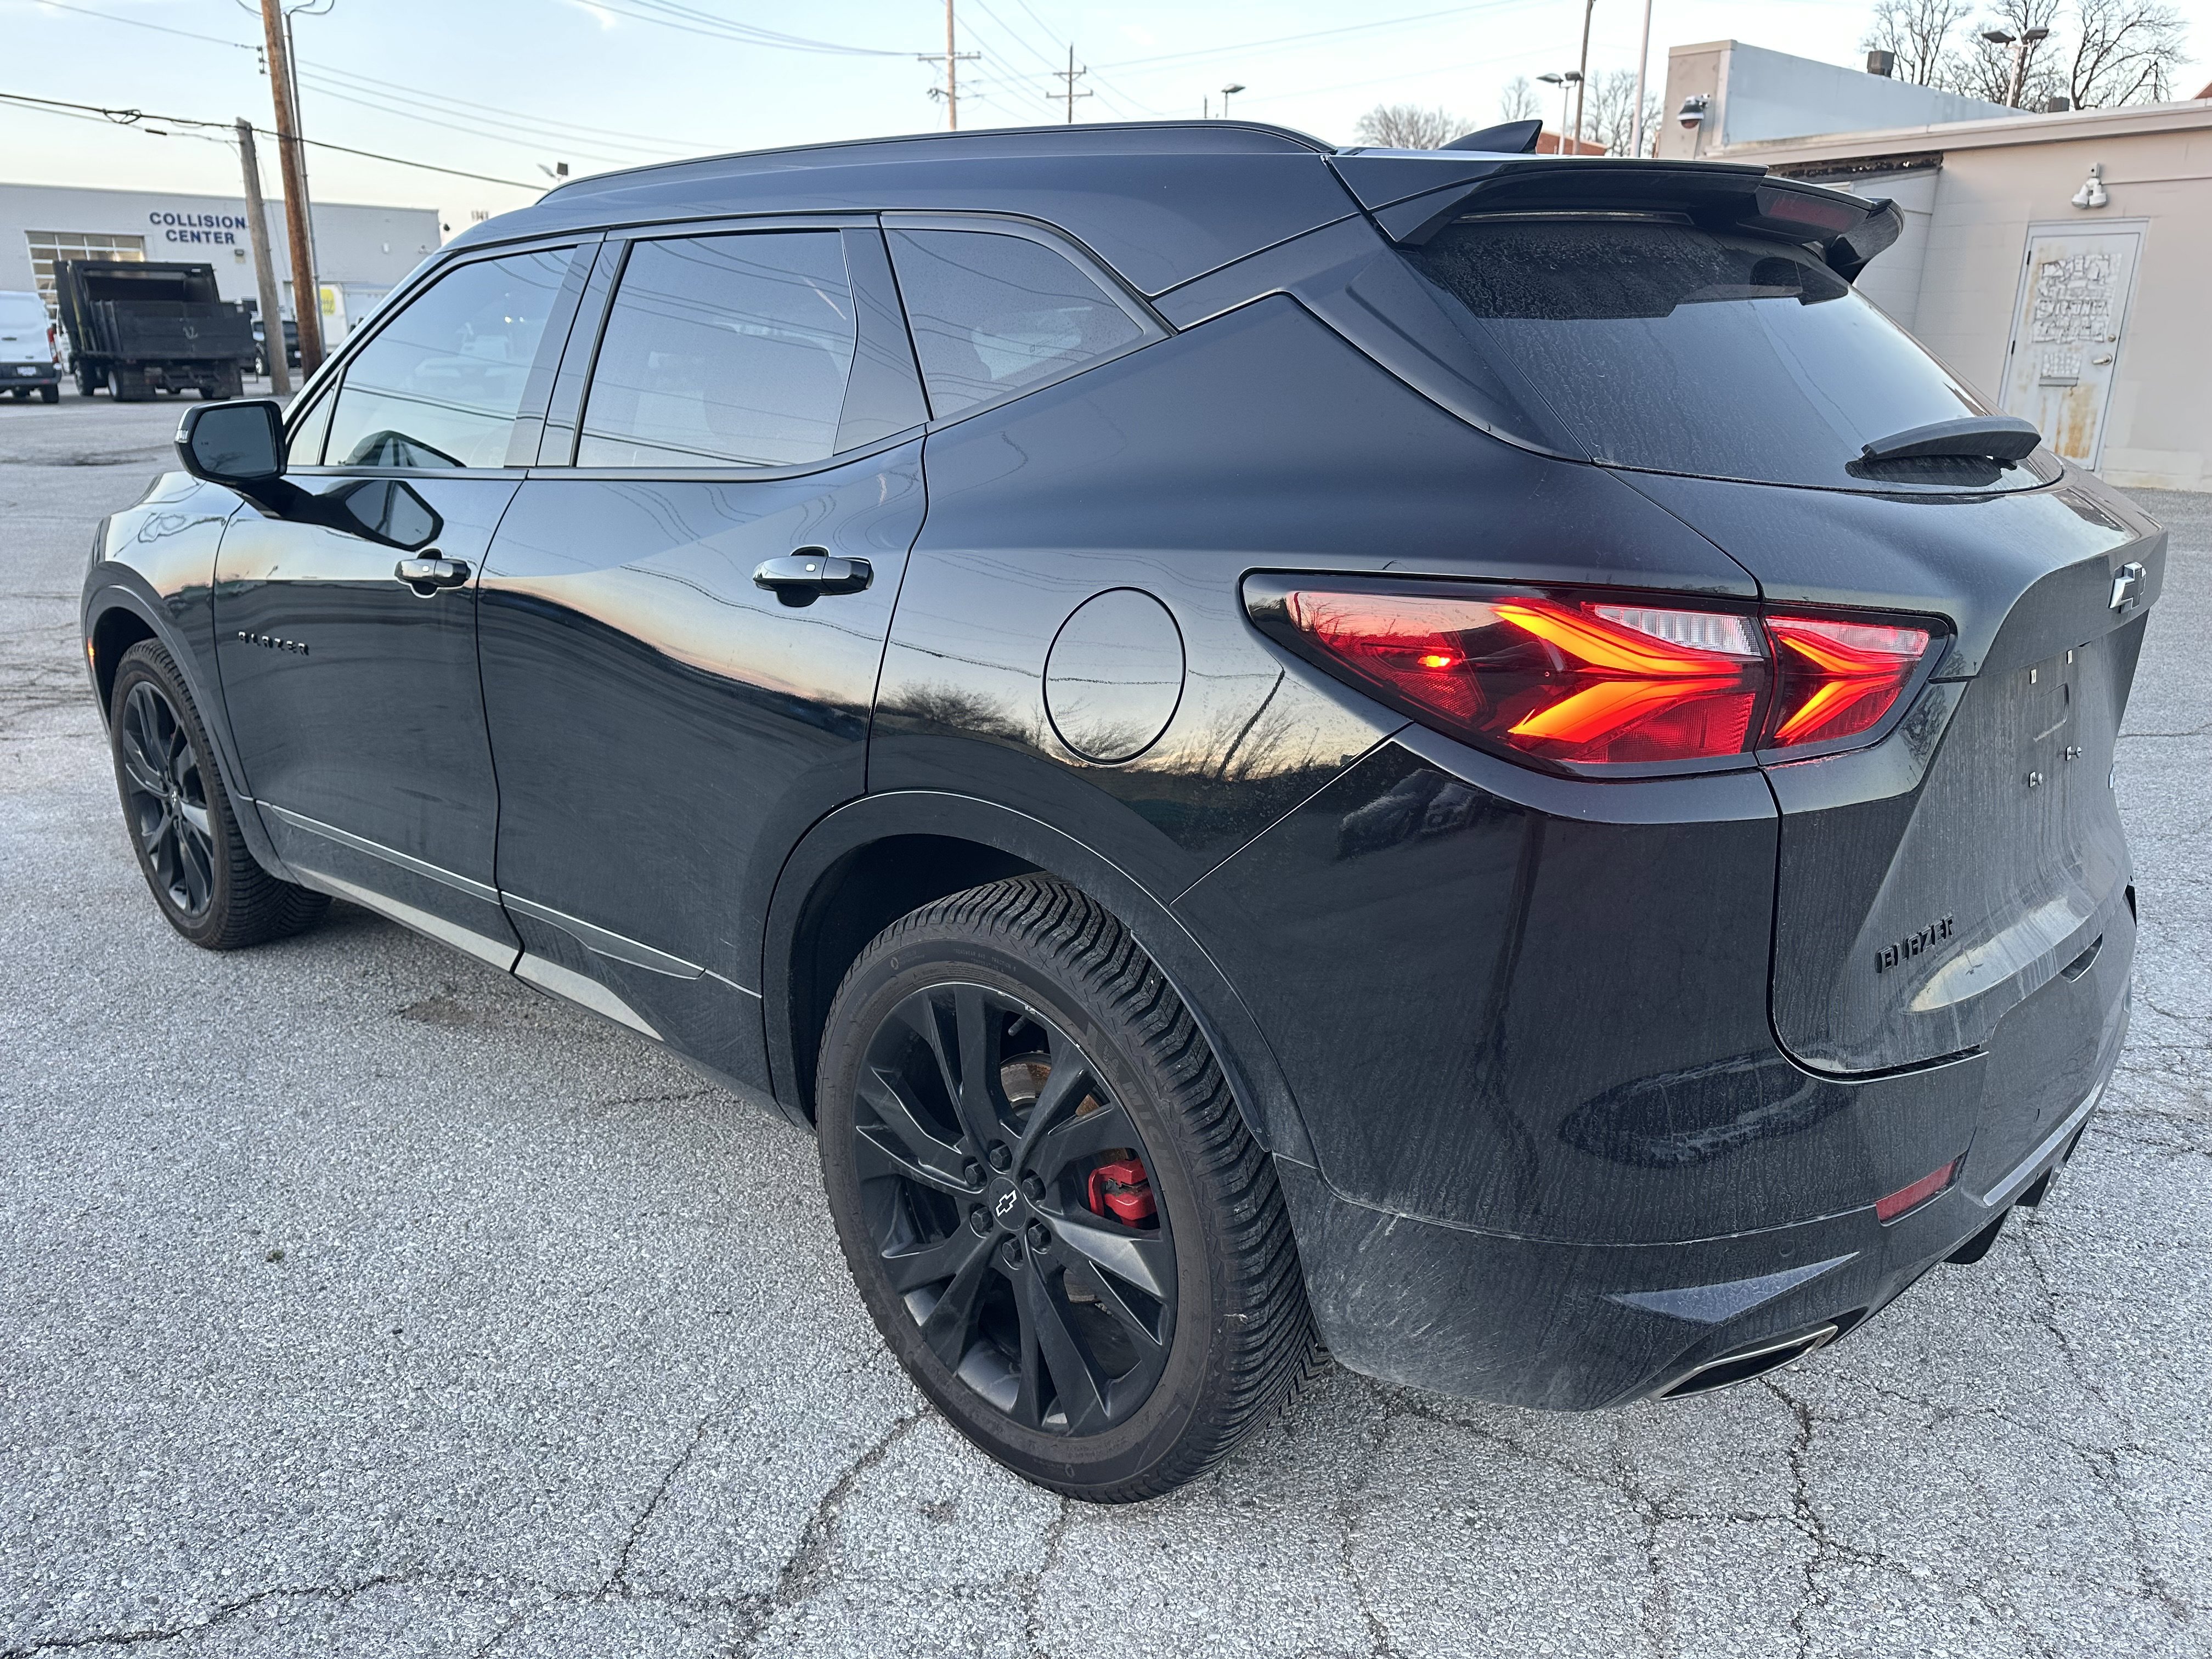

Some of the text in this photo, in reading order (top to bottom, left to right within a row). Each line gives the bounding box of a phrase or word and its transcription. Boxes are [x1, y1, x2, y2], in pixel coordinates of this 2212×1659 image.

[149, 212, 245, 229] COLLISION
[166, 229, 235, 244] CENTER
[1875, 914, 1953, 973] BLAZER
